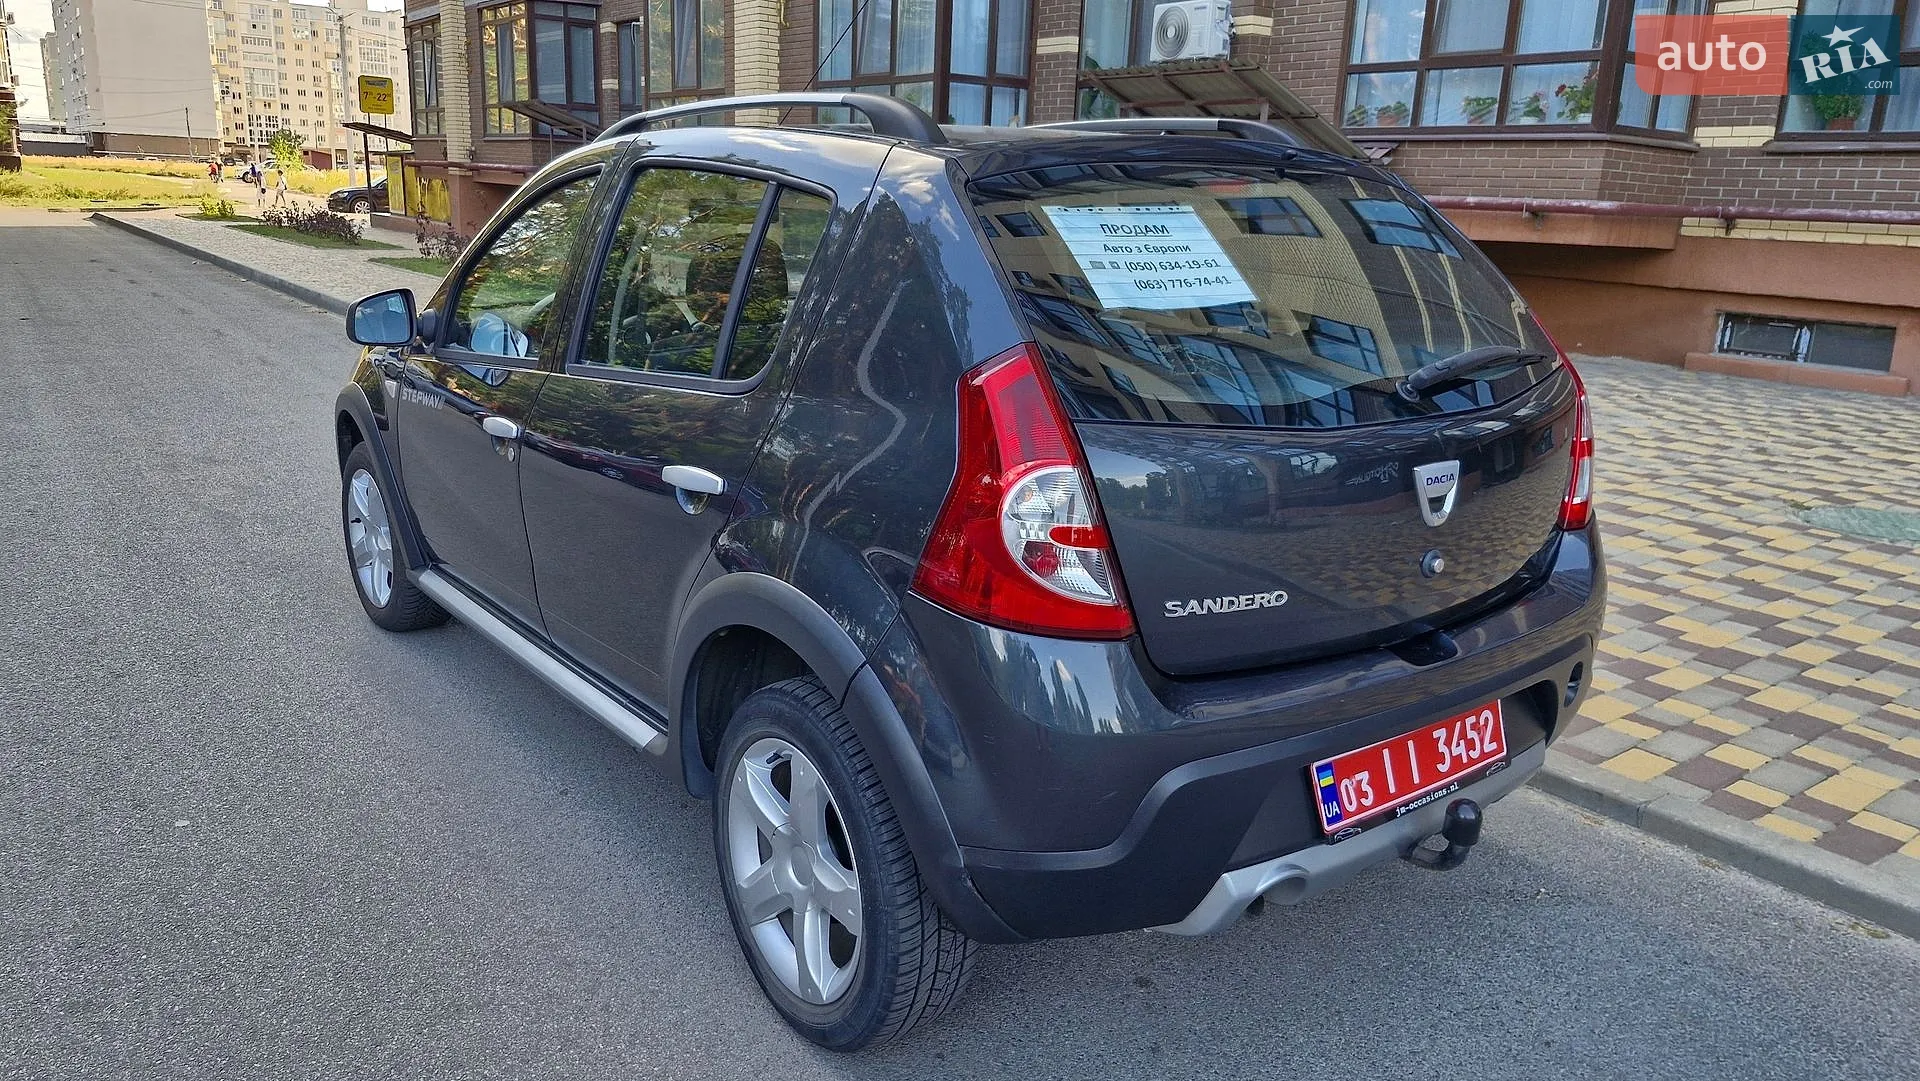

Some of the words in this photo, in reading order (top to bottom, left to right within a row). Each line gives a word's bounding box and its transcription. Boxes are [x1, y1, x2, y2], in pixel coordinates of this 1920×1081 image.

[1099, 223, 1171, 236] ПРОДАМ
[1103, 243, 1133, 253] Авто
[1143, 244, 1192, 255] Європи
[1124, 260, 1158, 273] (050)
[1158, 258, 1221, 271] 634-19-61
[1133, 279, 1168, 291] (063)
[1168, 275, 1232, 288] 776-74-41
[402, 388, 441, 409] STEPWAY
[1426, 473, 1455, 486] DACIA
[1163, 590, 1289, 618] SANDERO
[1340, 770, 1374, 812] 03
[1432, 709, 1498, 773] 3452
[1395, 781, 1460, 818] jm-occasions.nl
[1324, 800, 1340, 818] UA
